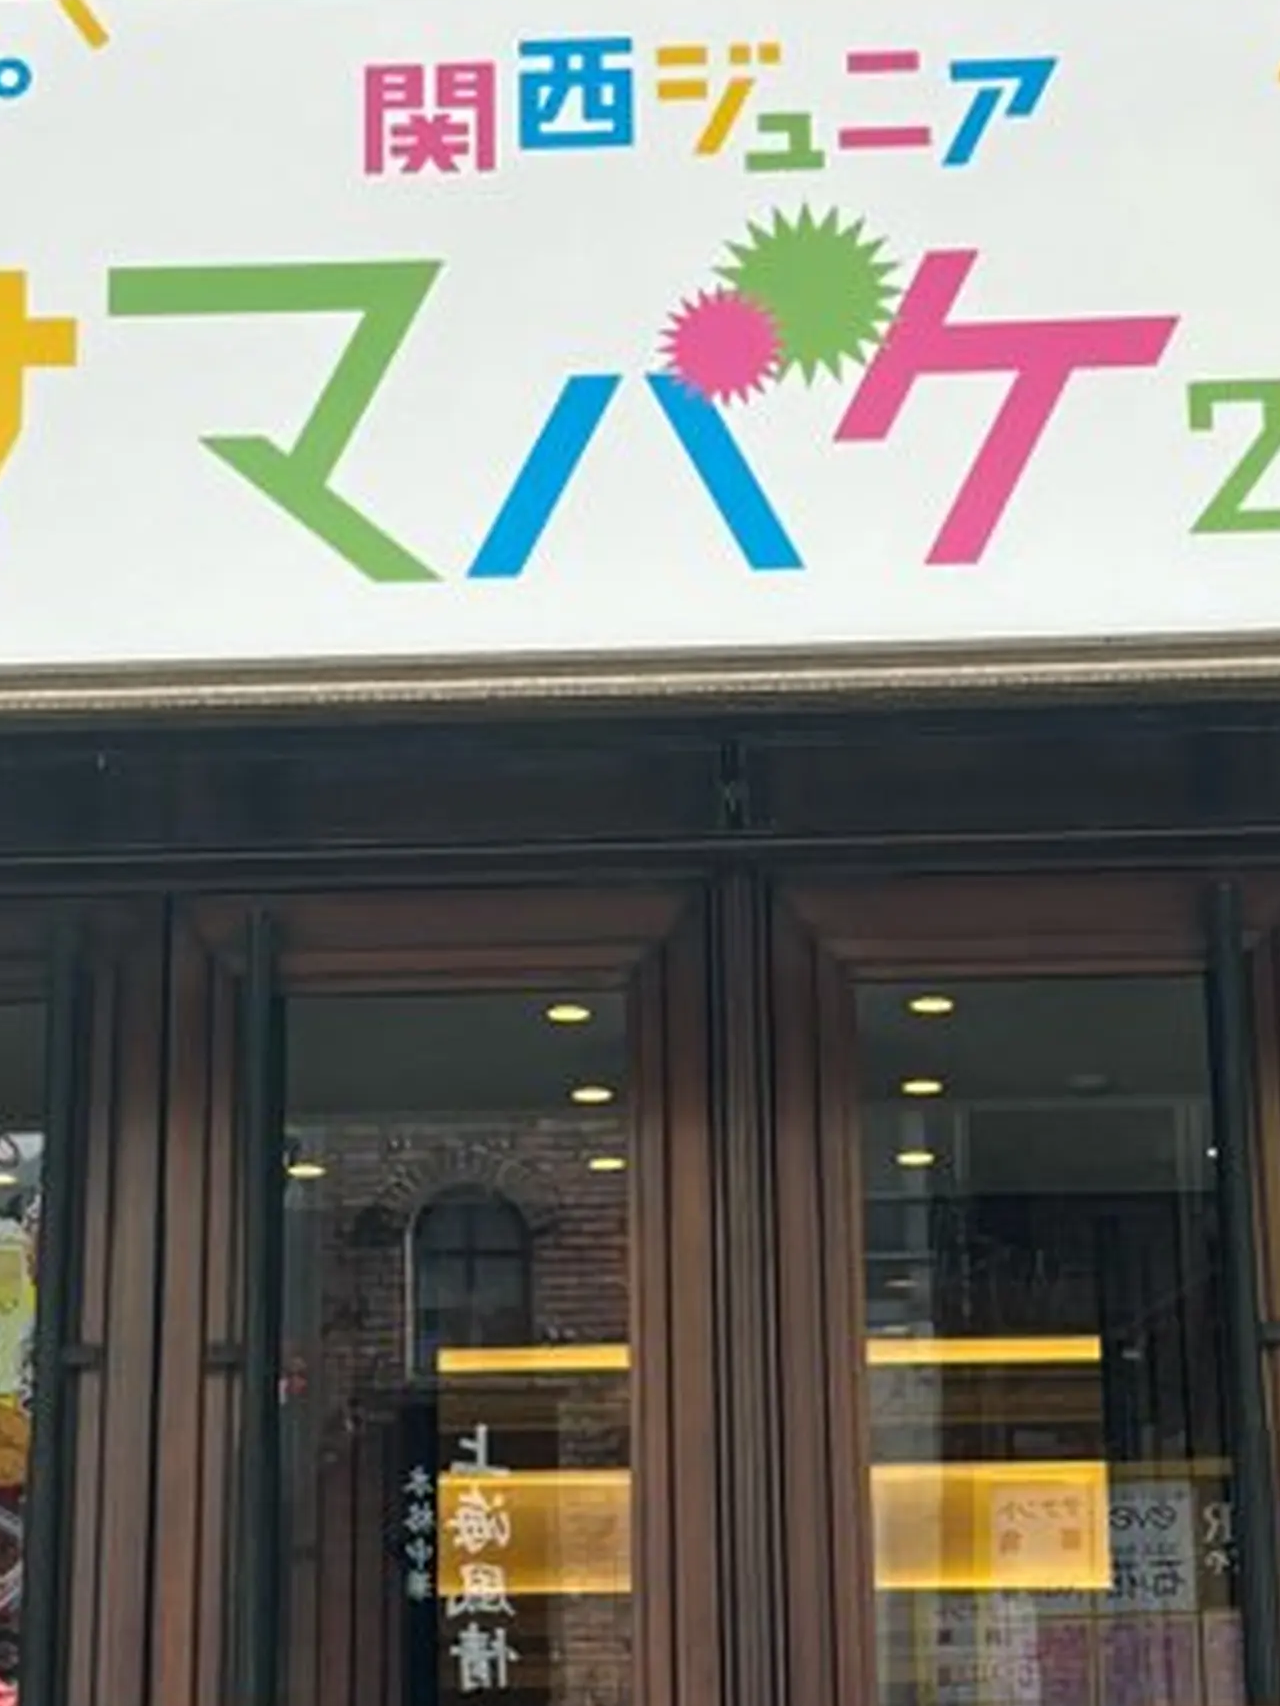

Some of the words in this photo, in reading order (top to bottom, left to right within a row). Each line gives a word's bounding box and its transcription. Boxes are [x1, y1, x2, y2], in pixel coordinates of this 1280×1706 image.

[363, 36, 1058, 175] 関西ジュニア
